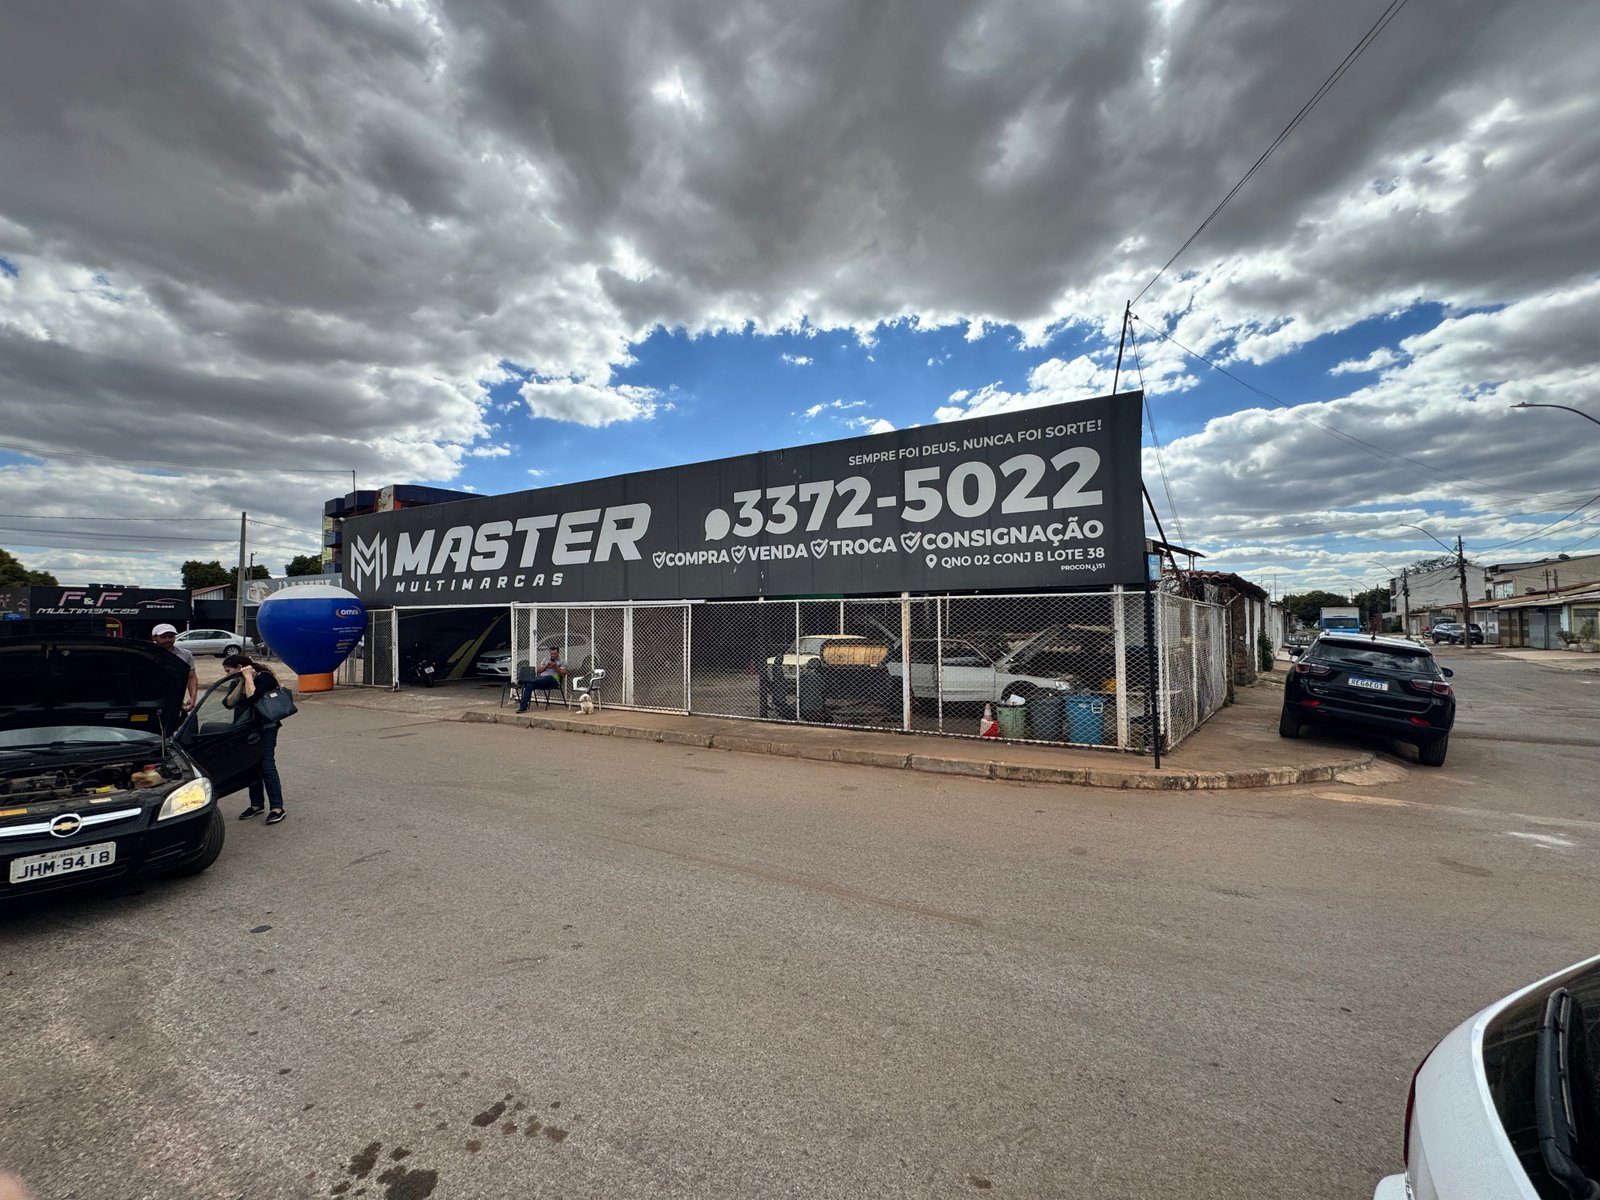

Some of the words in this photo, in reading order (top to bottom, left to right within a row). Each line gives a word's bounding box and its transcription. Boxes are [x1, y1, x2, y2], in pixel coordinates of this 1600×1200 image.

[848, 449, 896, 466] SEMPRE
[899, 446, 919, 459] FOI
[922, 441, 960, 456] DEUS,
[963, 433, 1014, 451] NUNCA
[1017, 427, 1042, 443] FOI
[1045, 419, 1102, 438] SORTE!
[733, 446, 1104, 539] 3372-5022
[392, 502, 652, 577] MASTER
[666, 549, 730, 566] COMPRA
[748, 543, 808, 562] VENDA
[829, 536, 897, 556] TROCA
[922, 516, 1104, 550] CONSIGNAÇÃO
[941, 555, 971, 569] QNO
[974, 554, 991, 566] 02
[993, 551, 1031, 564] CONJ
[1034, 551, 1044, 562] B
[1047, 548, 1083, 562] LOTE
[1087, 547, 1105, 559] 38
[395, 572, 564, 593] MULTIMARCAS
